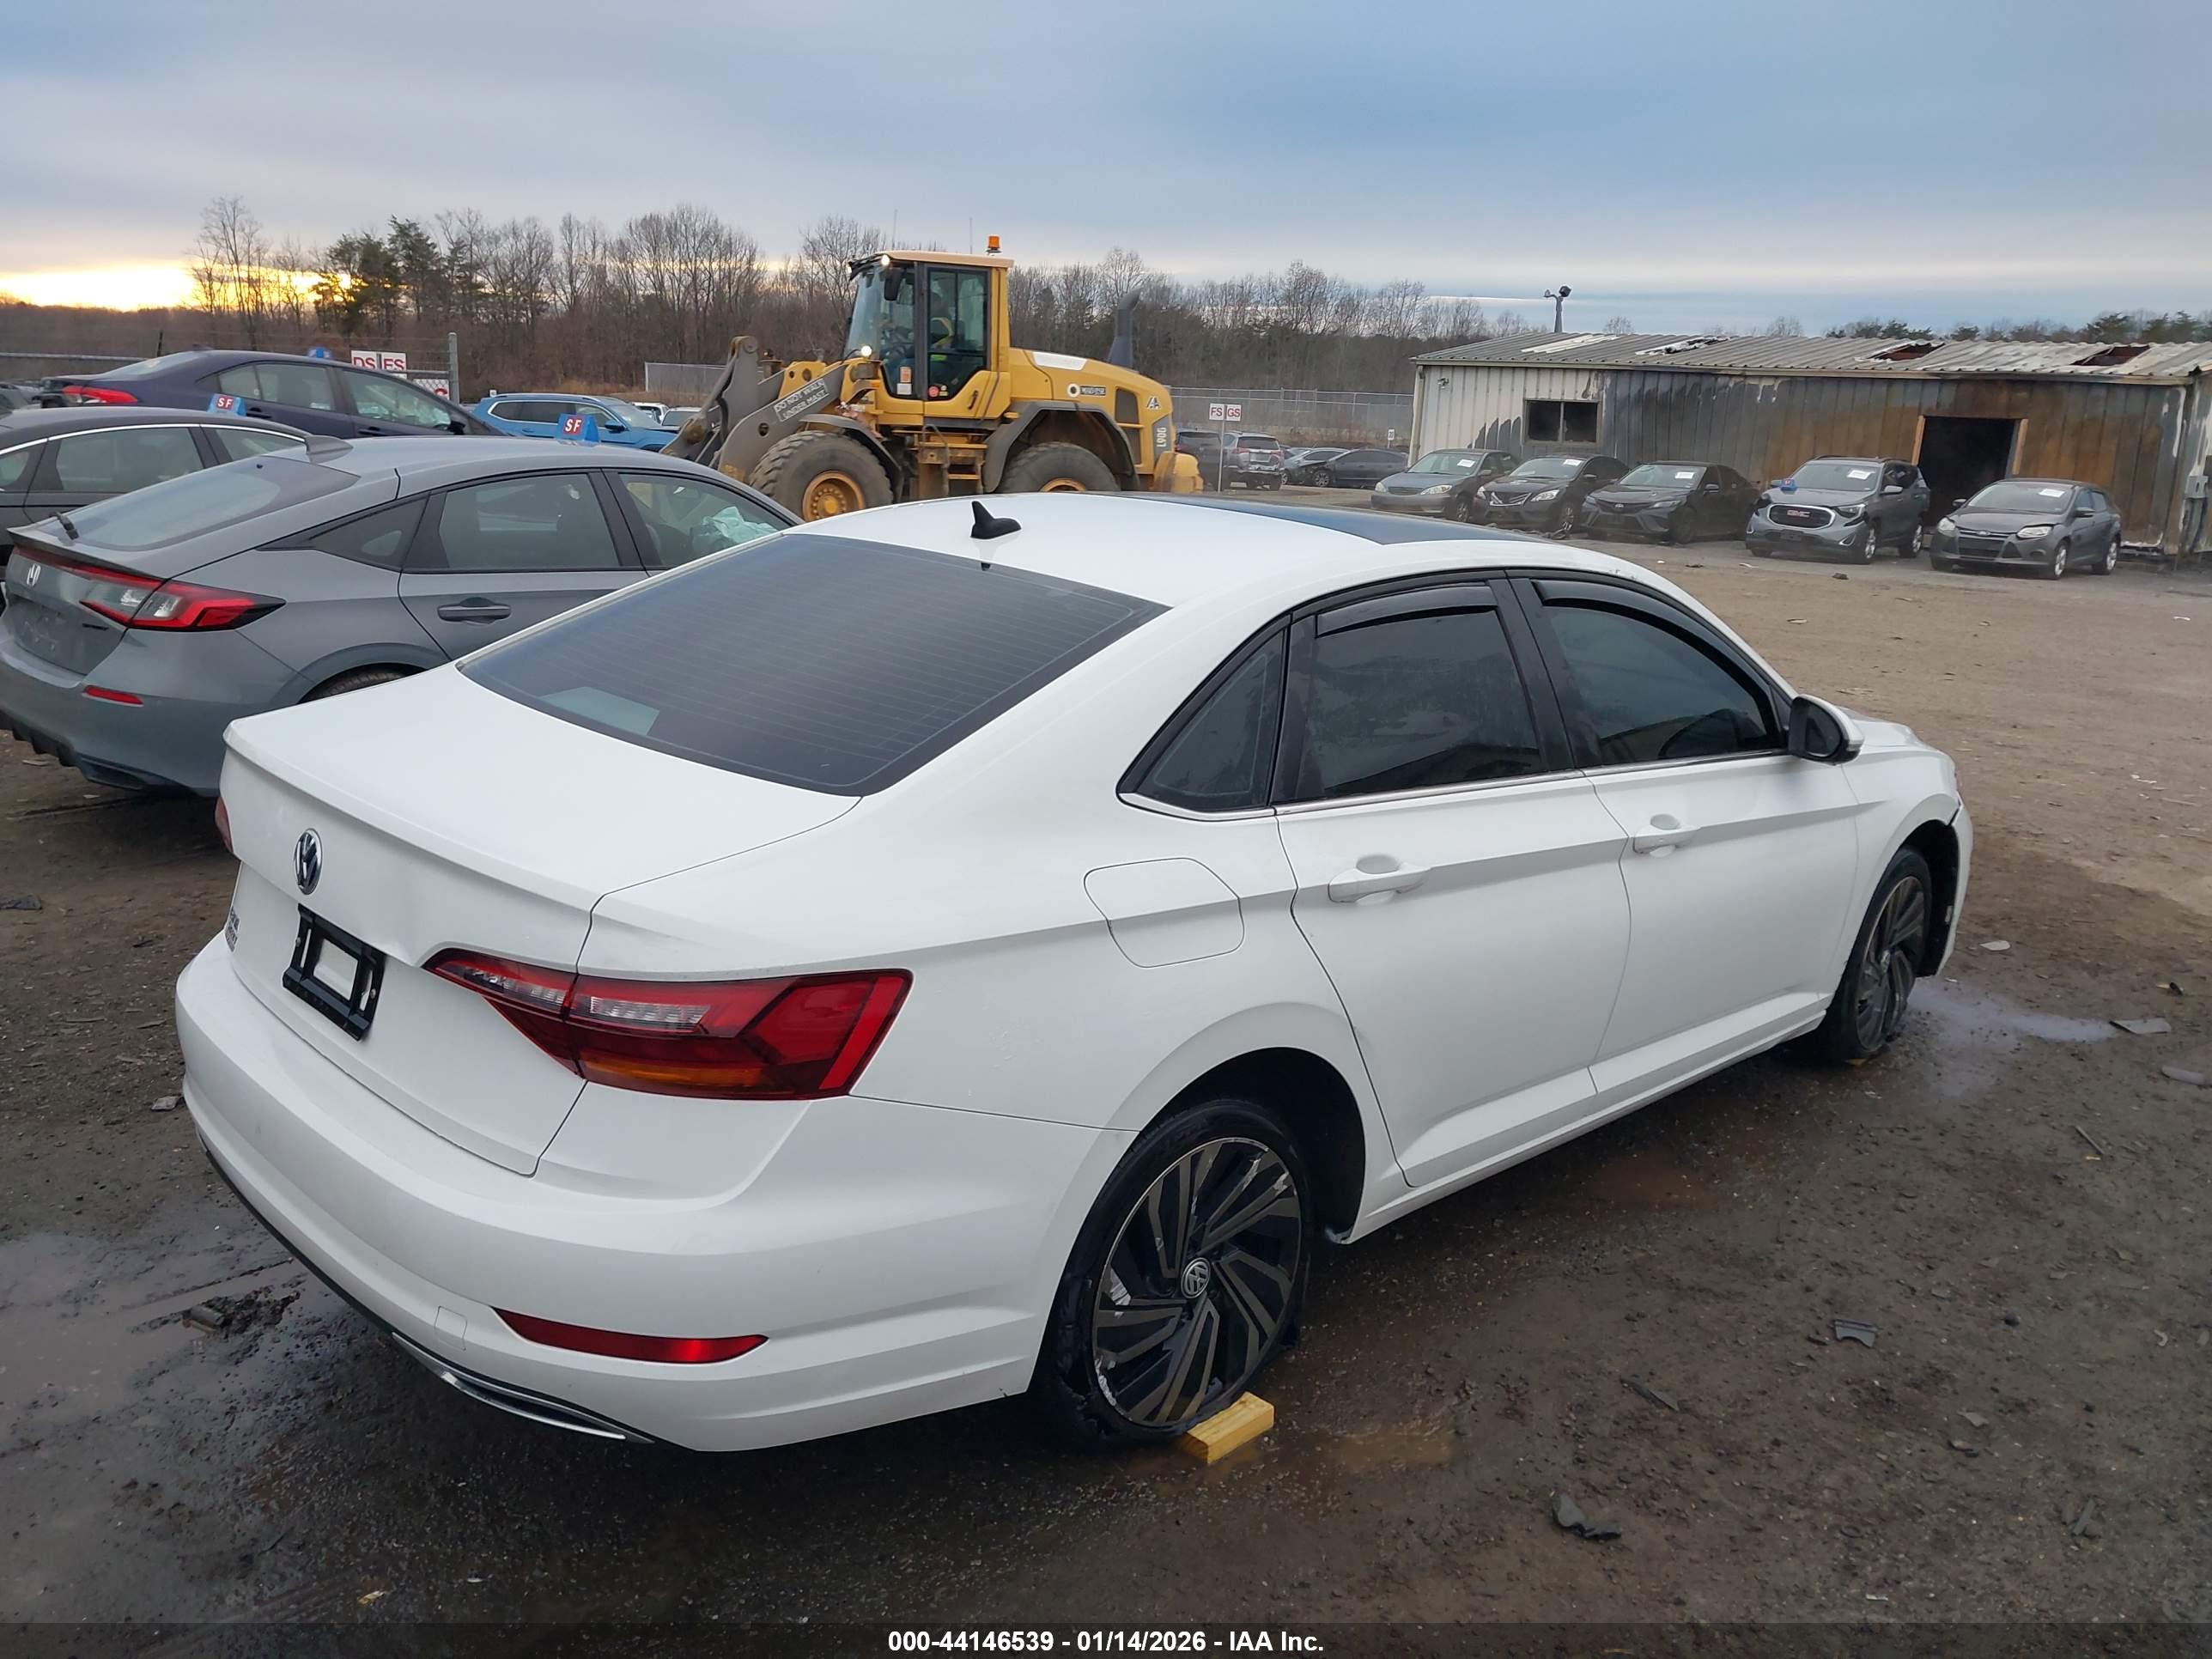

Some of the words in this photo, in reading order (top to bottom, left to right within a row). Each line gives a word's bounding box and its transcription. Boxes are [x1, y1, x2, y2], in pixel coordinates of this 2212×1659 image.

[217, 398, 234, 408] SF
[1211, 407, 1223, 416] FS
[1227, 408, 1241, 417] GS
[565, 418, 582, 432] SF
